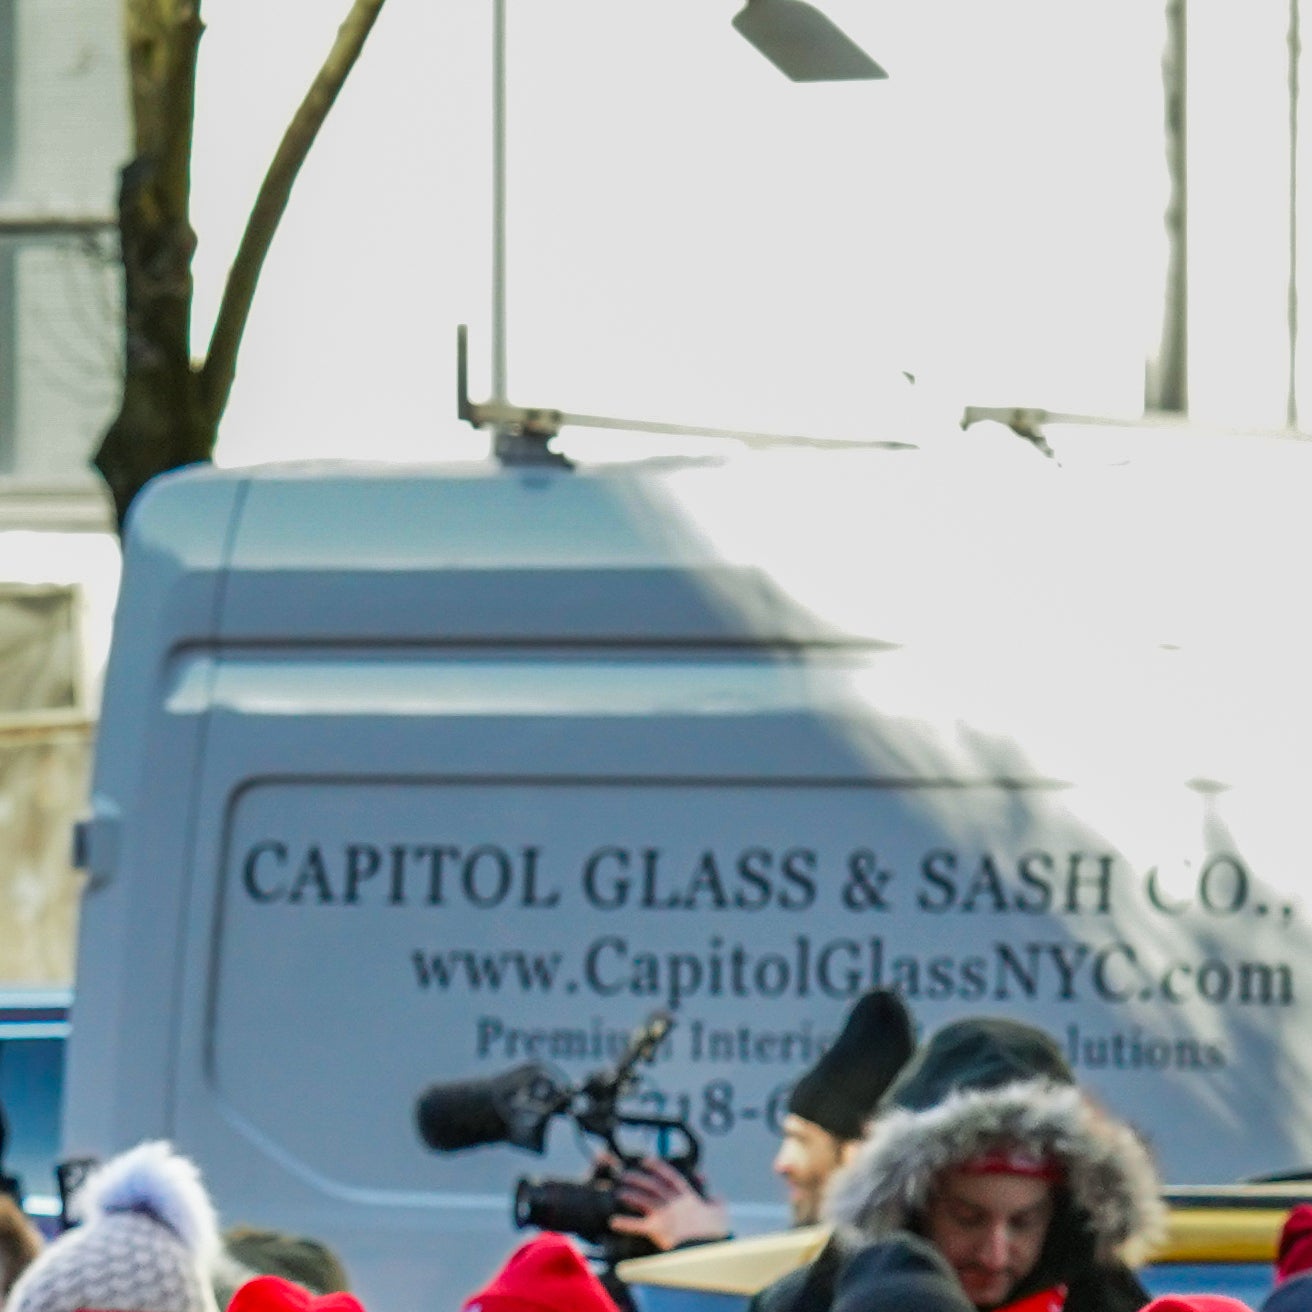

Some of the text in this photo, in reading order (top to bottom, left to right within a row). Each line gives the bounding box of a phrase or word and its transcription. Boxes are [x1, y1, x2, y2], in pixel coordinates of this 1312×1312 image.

[242, 839, 560, 908] CAPITOL
[581, 845, 818, 912] GLASS
[841, 847, 892, 912] &
[919, 850, 1113, 918] SASH
[410, 935, 1295, 1006] www.CapitolGlassNYC.com
